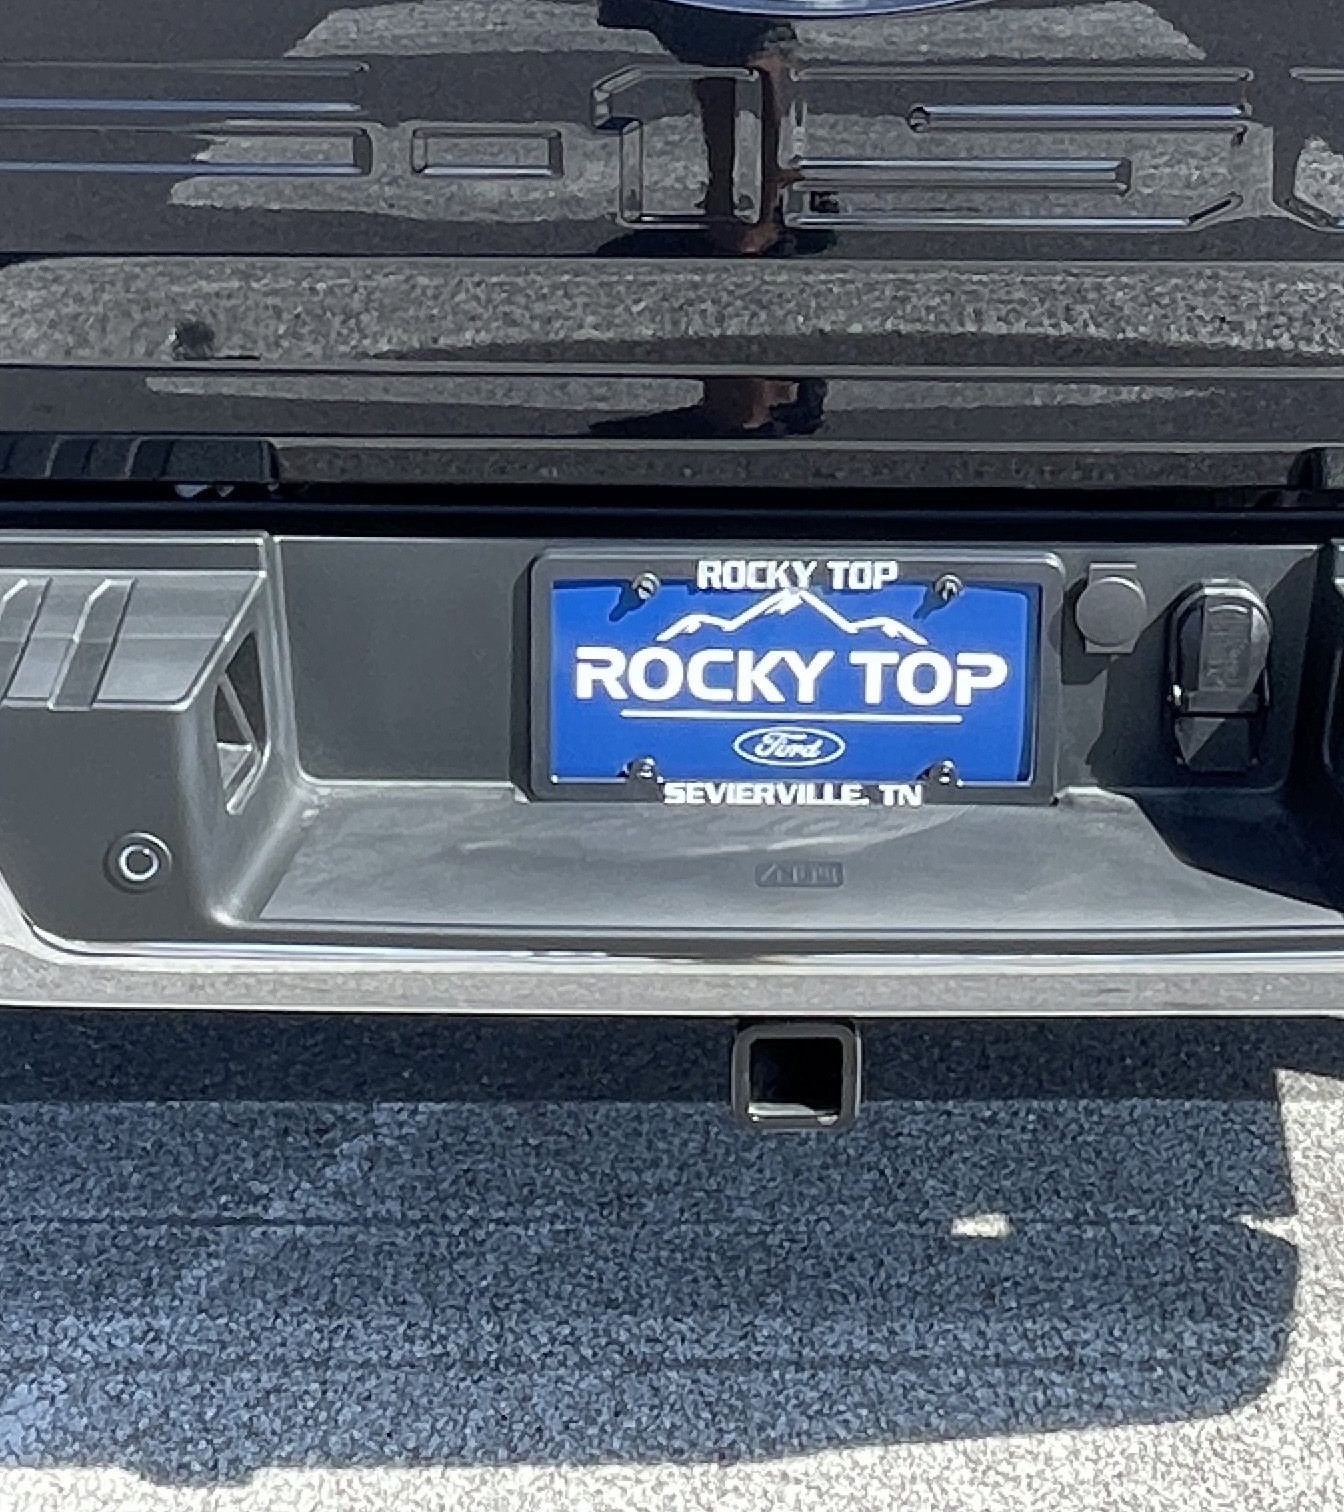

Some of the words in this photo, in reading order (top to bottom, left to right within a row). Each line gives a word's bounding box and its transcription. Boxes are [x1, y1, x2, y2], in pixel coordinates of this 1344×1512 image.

[697, 559, 818, 590] ROCKY
[827, 560, 898, 590] TOP
[575, 646, 835, 705] ROCKY
[849, 651, 1008, 706] TOP
[754, 732, 824, 758] Ford
[879, 784, 922, 807] TN
